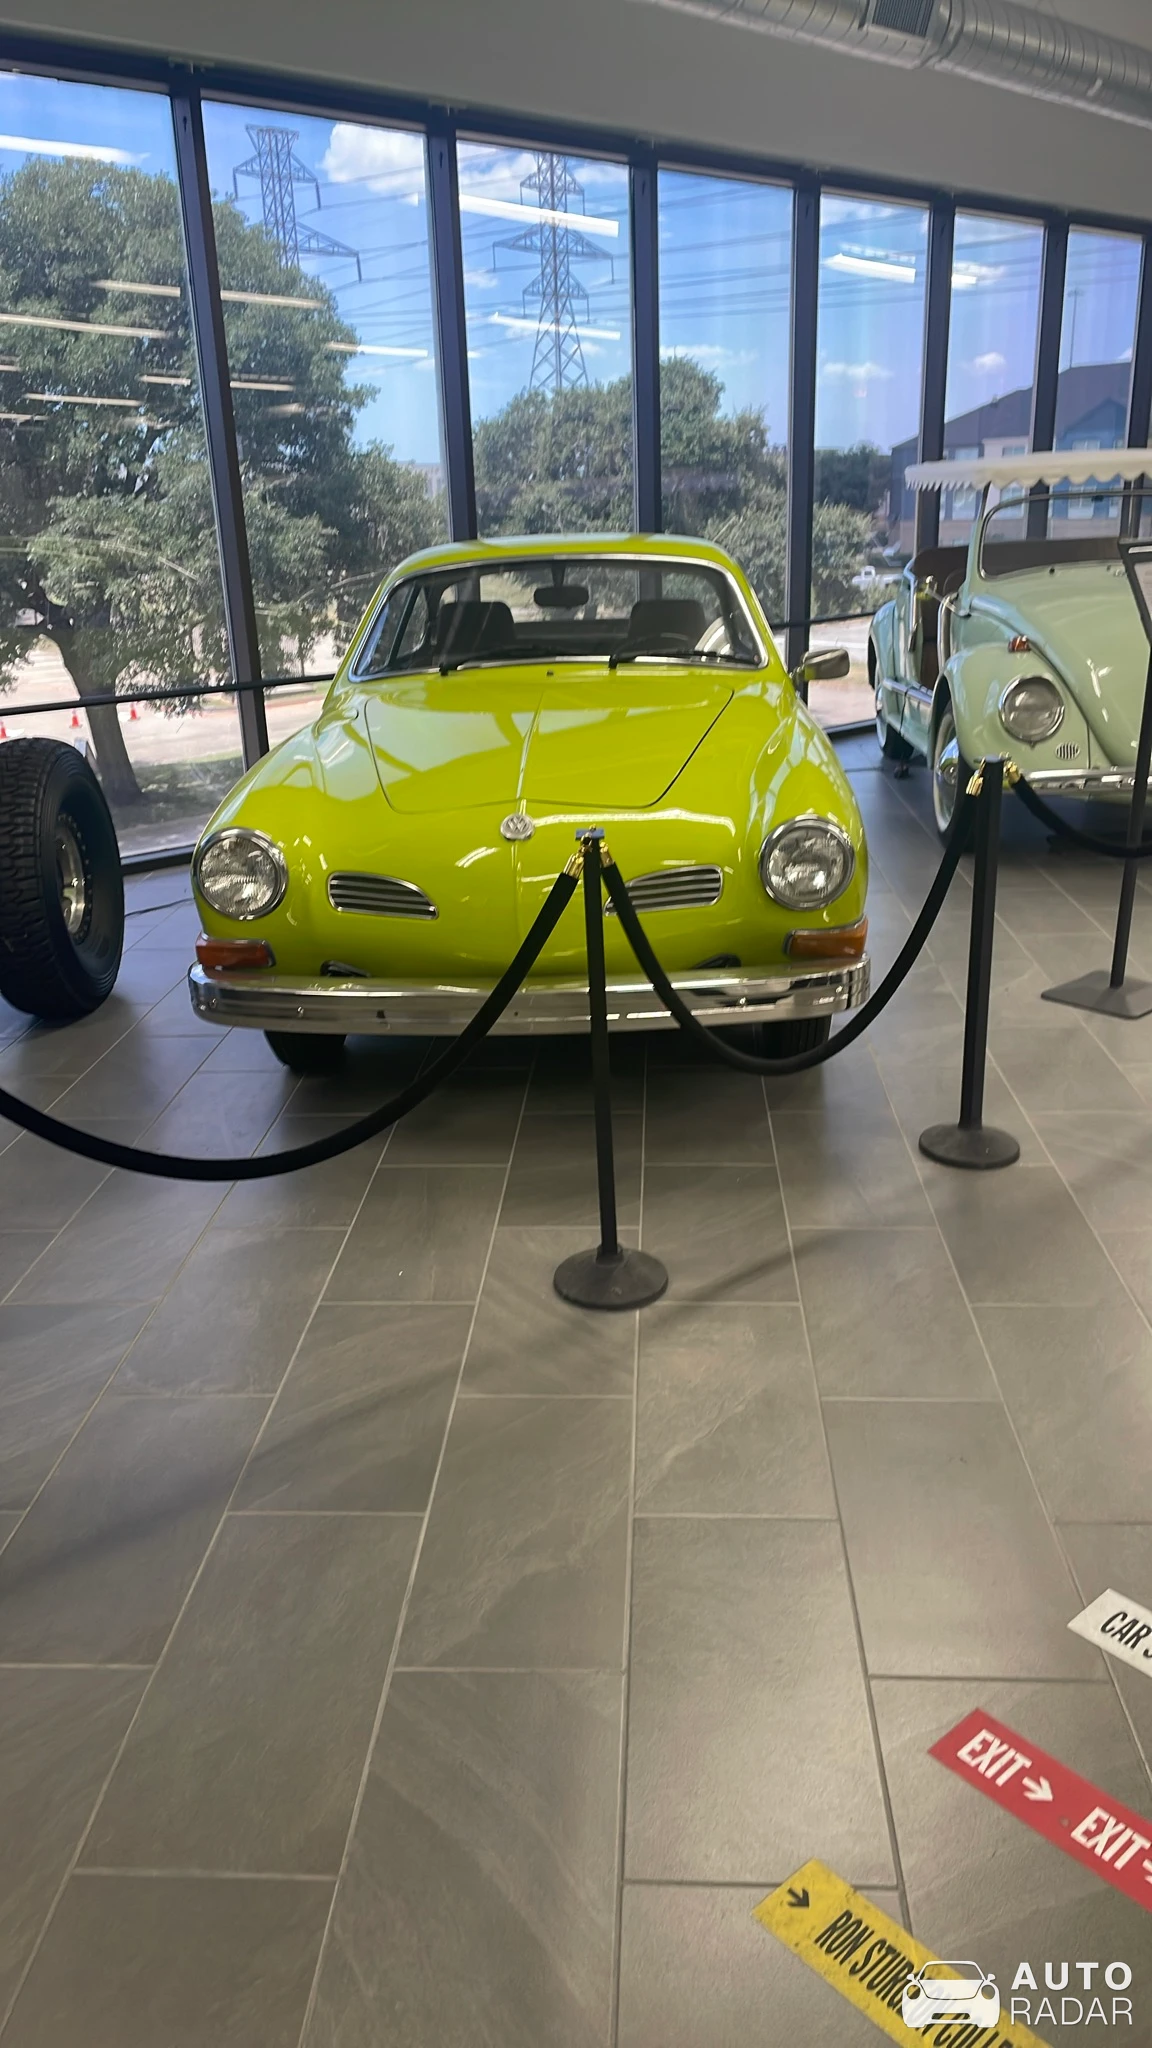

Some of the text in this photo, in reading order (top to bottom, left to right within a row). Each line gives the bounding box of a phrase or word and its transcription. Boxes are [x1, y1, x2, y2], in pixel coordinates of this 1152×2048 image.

[1100, 1611, 1152, 1650] CAR
[957, 1728, 1152, 1871] EXIT EXIT
[814, 1909, 875, 1966] RON
